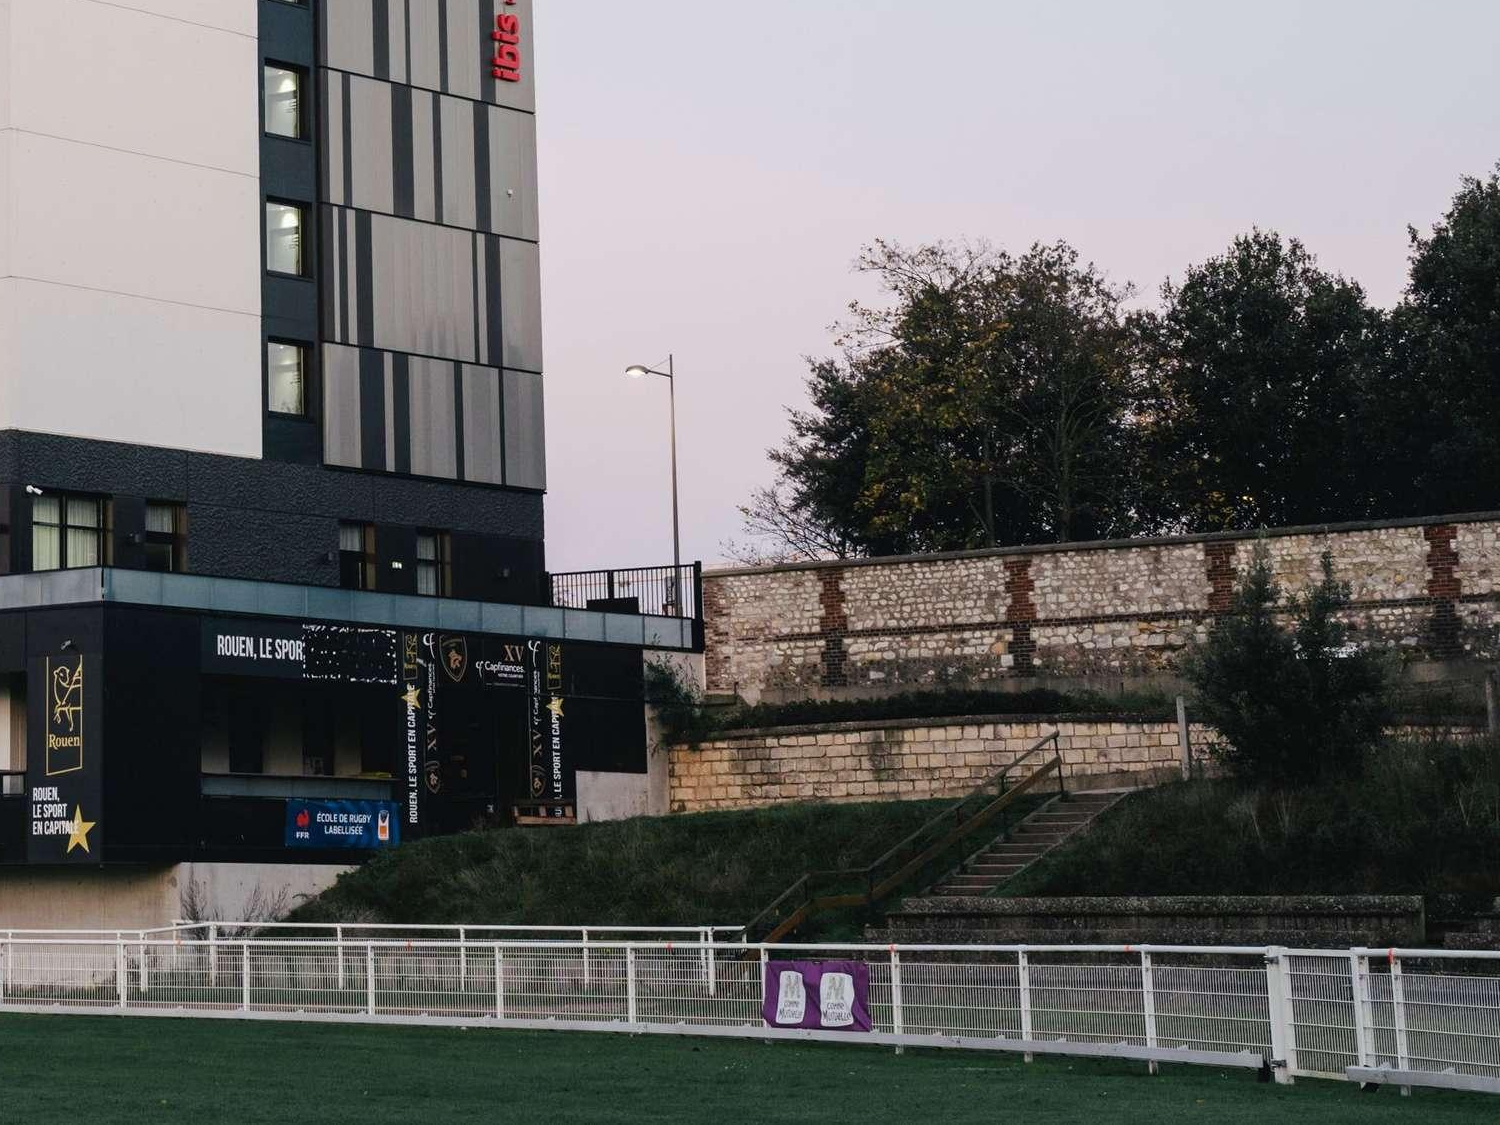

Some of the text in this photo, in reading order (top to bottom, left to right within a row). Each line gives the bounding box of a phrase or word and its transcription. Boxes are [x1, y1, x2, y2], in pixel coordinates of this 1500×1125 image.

[492, 14, 520, 82] ibis
[217, 635, 304, 661] ROUEN, LE SPOR
[504, 644, 525, 662] XV
[49, 733, 81, 750] Rouen
[407, 729, 417, 743] EN
[552, 737, 561, 750] EN
[408, 744, 417, 774] SPORT
[552, 751, 561, 780] SPORT
[409, 776, 417, 788] LE
[553, 781, 562, 793] LE
[32, 787, 60, 802] ROUEN,
[32, 803, 68, 818] LE SPORT
[316, 811, 372, 824] ÉCOLE DE RUGBY
[32, 821, 43, 835] EN
[295, 831, 310, 839] FFR
[324, 825, 363, 835] LABELLISÉE
